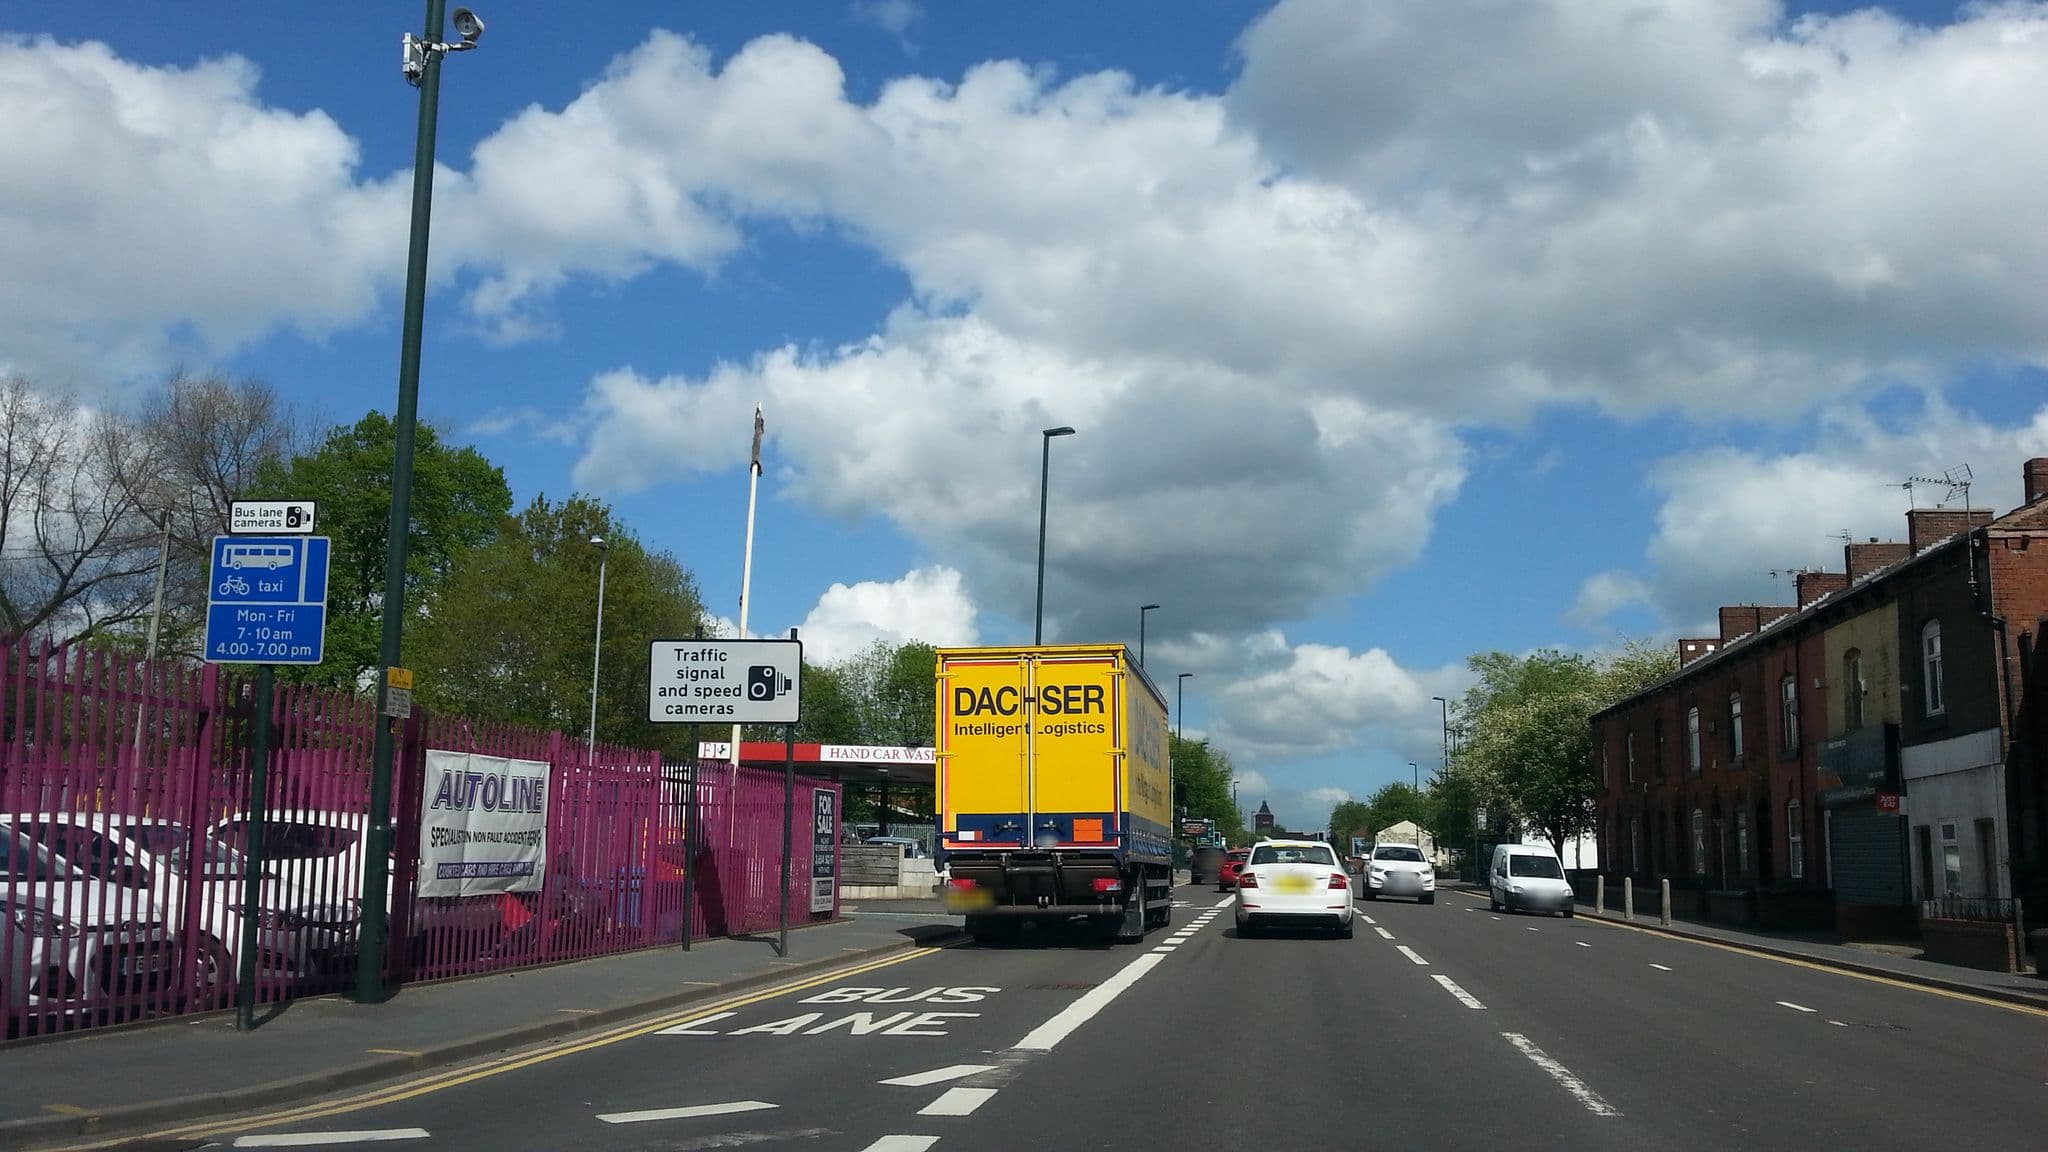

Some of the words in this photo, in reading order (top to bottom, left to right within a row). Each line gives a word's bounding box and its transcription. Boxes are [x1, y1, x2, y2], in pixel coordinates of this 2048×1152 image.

[234, 508, 255, 518] Bus
[259, 508, 283, 518] lane
[234, 518, 282, 528] cameras
[258, 580, 284, 592] taxi
[291, 646, 312, 659] pm
[674, 648, 728, 662] Traffic
[676, 666, 725, 682] signal
[658, 684, 688, 697] and
[694, 684, 742, 699] speed
[954, 684, 1105, 716] DACHSER
[665, 704, 734, 715] cameras
[830, 748, 870, 759] HAND
[873, 748, 900, 760] CAR
[431, 769, 545, 814] AUTOLINE
[818, 795, 832, 815] FOR
[818, 814, 832, 834] SALE
[473, 831, 486, 843] NON
[487, 831, 503, 843] FAULT
[504, 831, 527, 845] ACCIDENT
[797, 987, 1001, 1004] BUS
[652, 1011, 981, 1036] LANE
